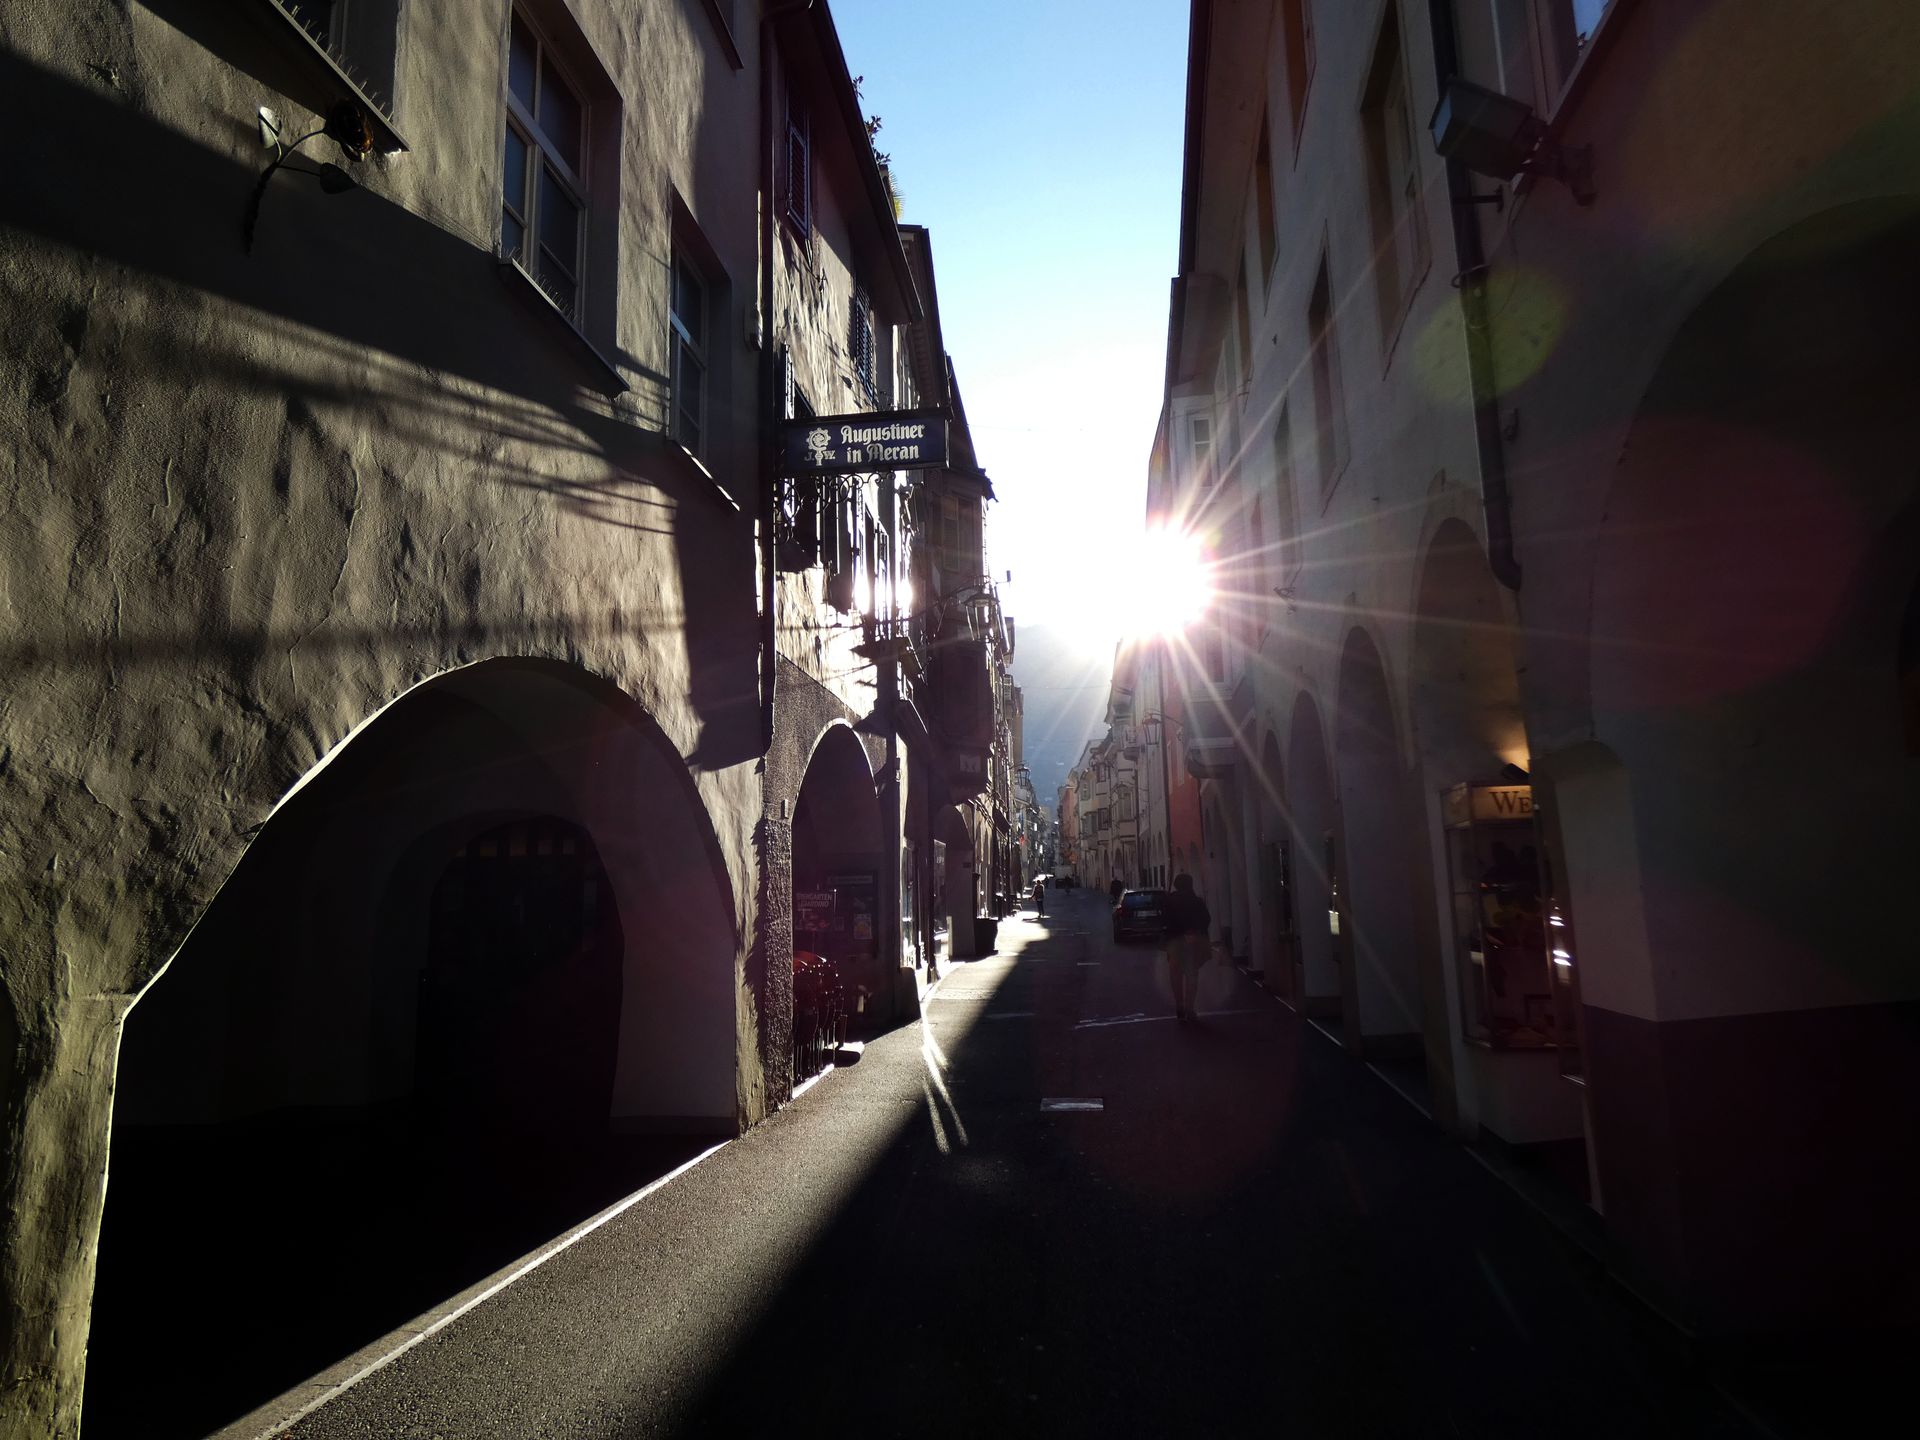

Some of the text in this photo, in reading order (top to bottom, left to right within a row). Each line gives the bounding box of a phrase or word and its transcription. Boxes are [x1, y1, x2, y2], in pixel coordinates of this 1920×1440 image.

[840, 423, 925, 445] Augustiner
[846, 443, 920, 464] in Meran
